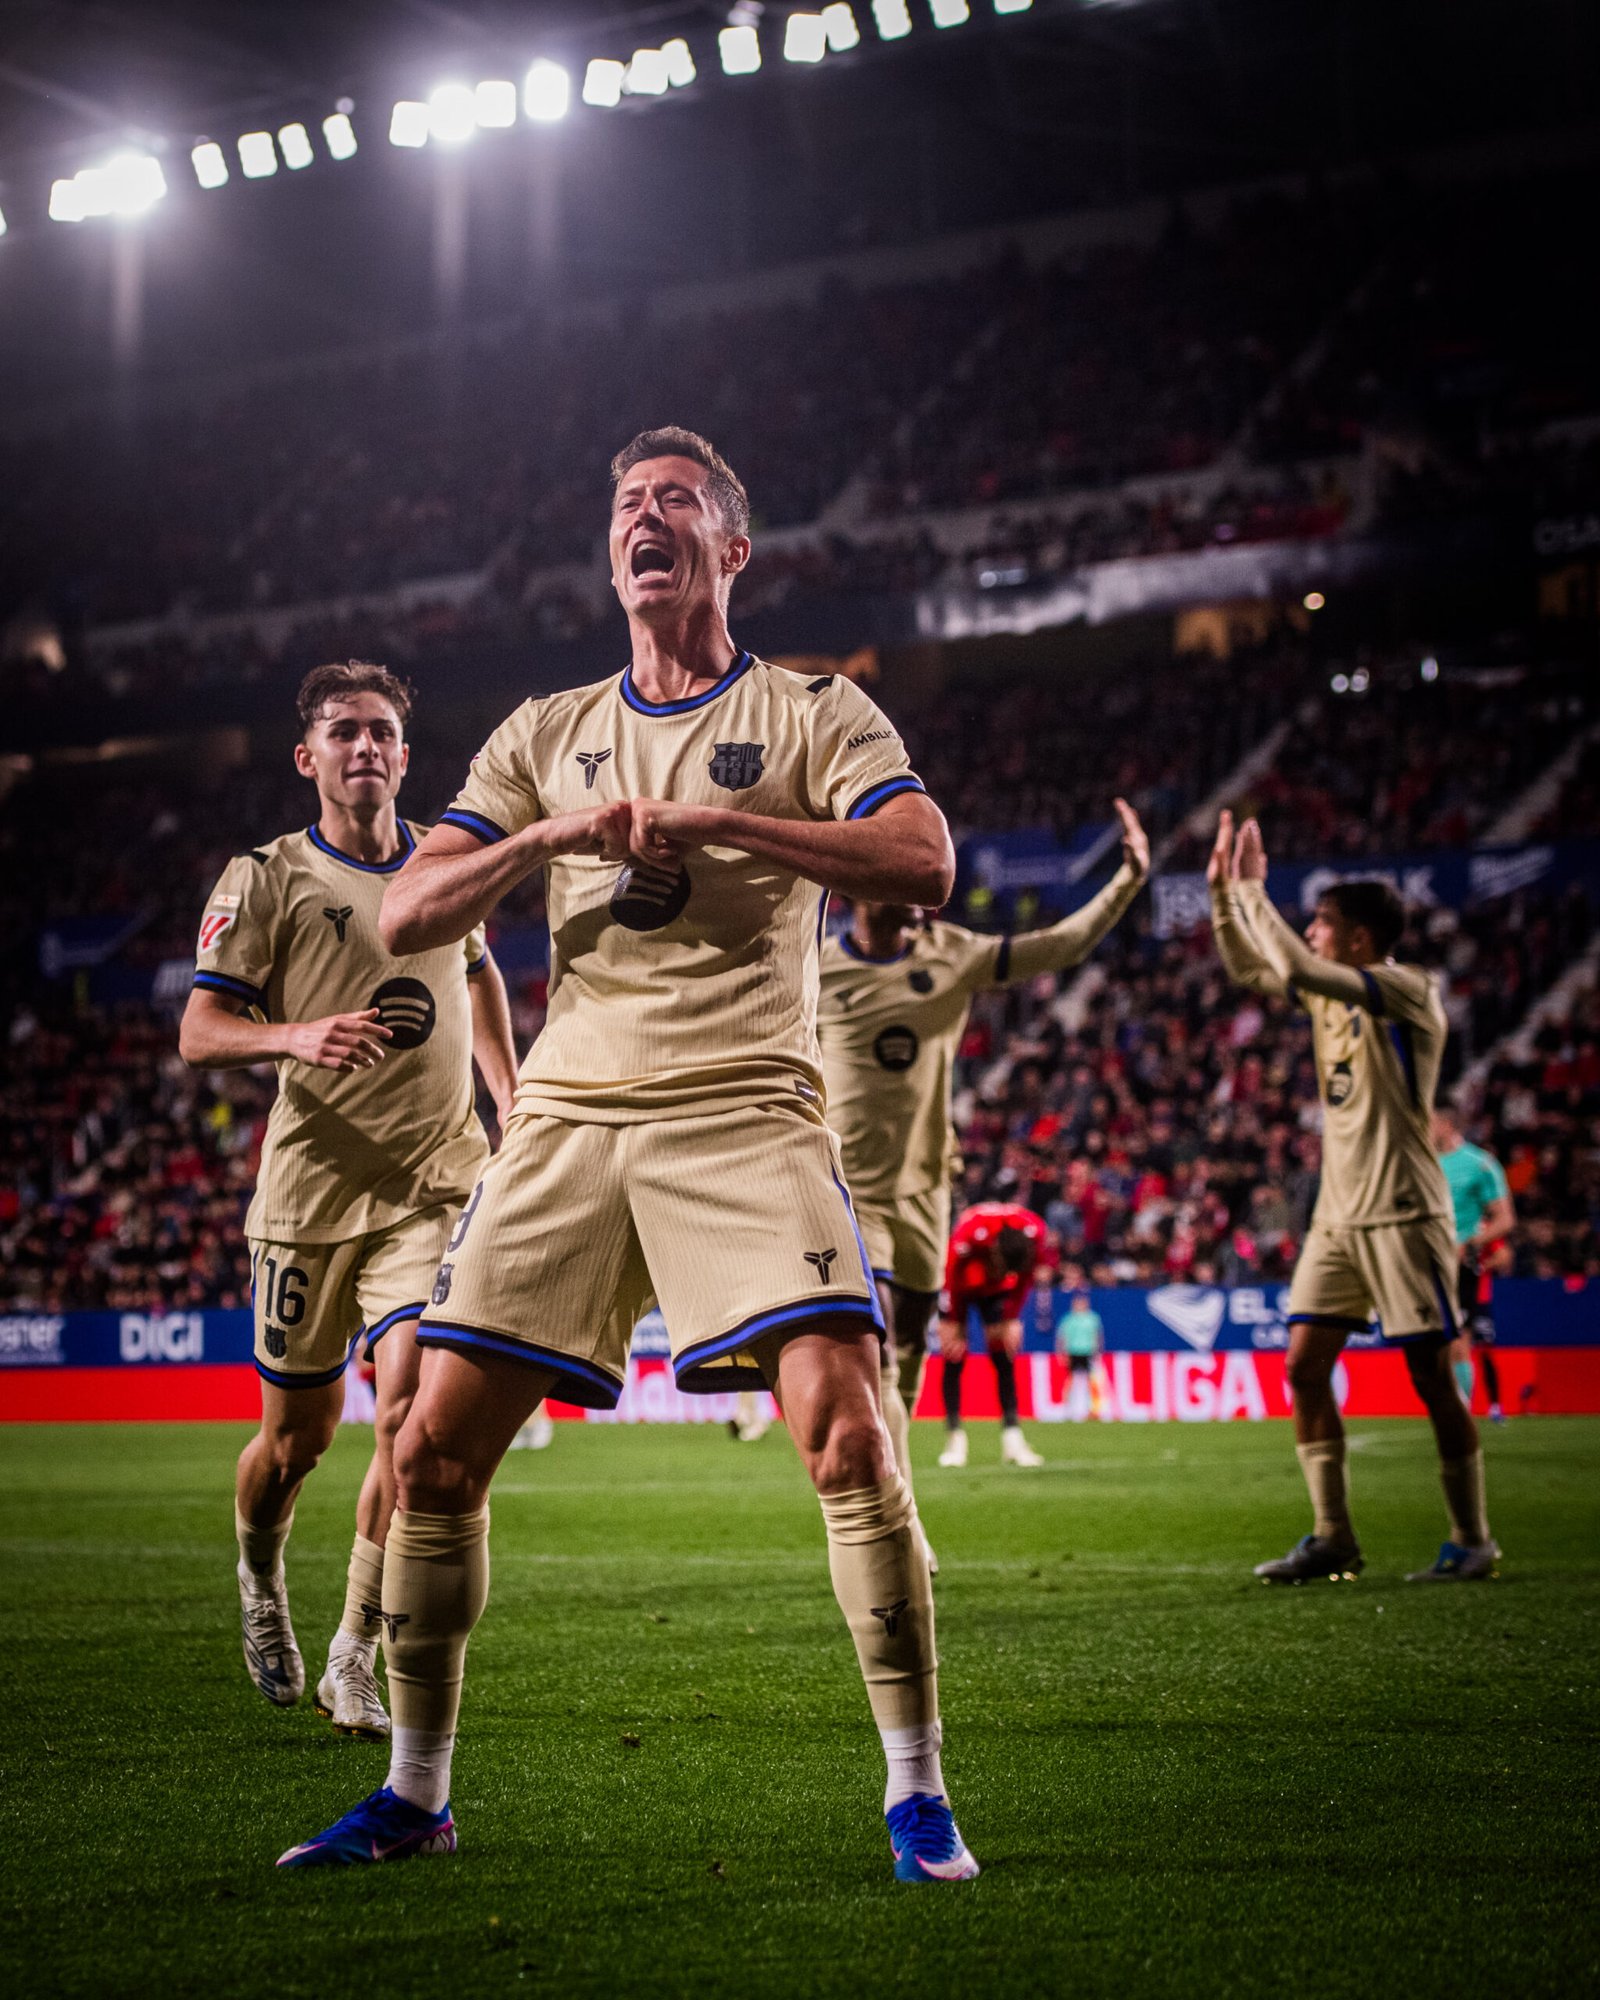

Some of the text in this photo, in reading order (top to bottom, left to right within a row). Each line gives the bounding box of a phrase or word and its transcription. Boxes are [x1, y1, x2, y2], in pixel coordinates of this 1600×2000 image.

[265, 1258, 308, 1326] 16
[1229, 1287, 1275, 1323] EL
[120, 1314, 203, 1361] DIGI
